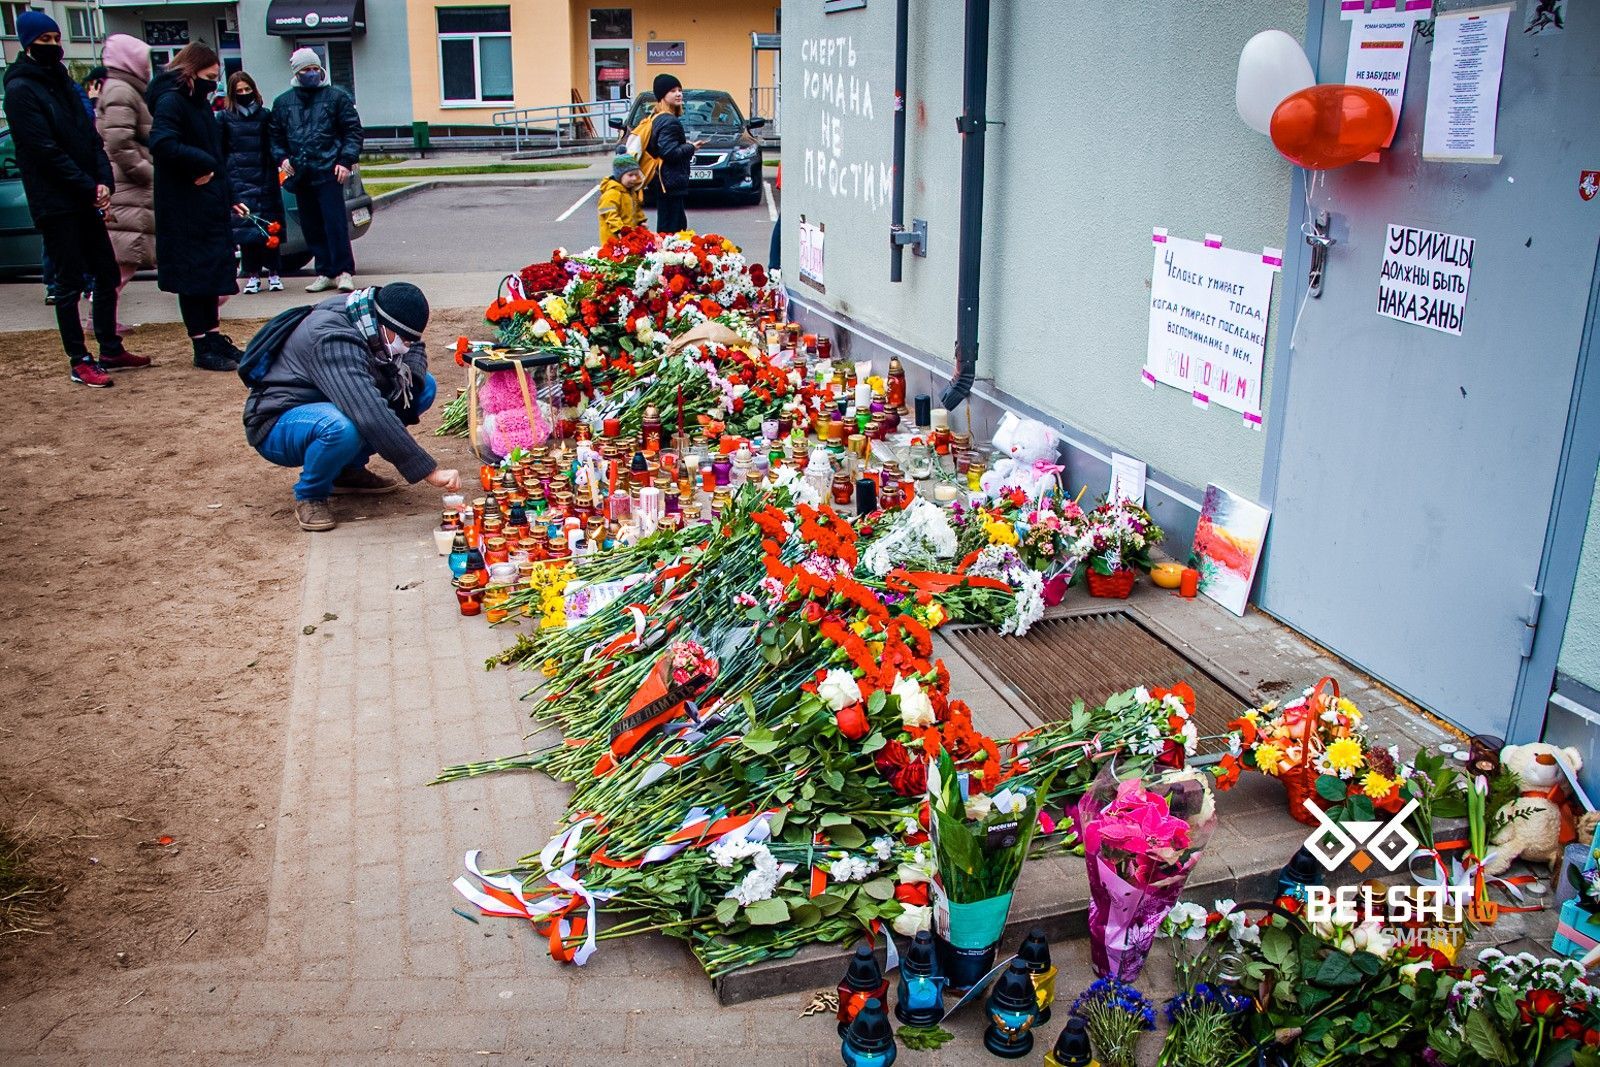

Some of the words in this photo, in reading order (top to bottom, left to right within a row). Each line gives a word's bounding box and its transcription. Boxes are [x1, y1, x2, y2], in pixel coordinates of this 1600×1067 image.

[801, 36, 857, 68] СМЕРТЬ
[1356, 71, 1366, 80] НЕ
[1366, 71, 1401, 81] ЗАБУДЕМ!
[803, 69, 874, 121] РОМАНА
[821, 109, 842, 158] НЕ
[804, 148, 894, 212] ПРОСТИМ
[1389, 227, 1475, 269] УБИЙЦЫ
[1207, 276, 1245, 296] УМИРАЕТ
[1380, 259, 1430, 287] ДОЛЖНЫ
[1432, 271, 1465, 294] БЫТЬ
[1152, 298, 1178, 313] КОГДА
[1180, 304, 1216, 327] УМИРАЕТ
[1377, 285, 1464, 332] НАКАЗАНЫ
[1167, 321, 1223, 351] ВОСПОМИНАНИЕ
[1224, 344, 1230, 354] О
[644, 685, 695, 719] ПАМЯТЬ
